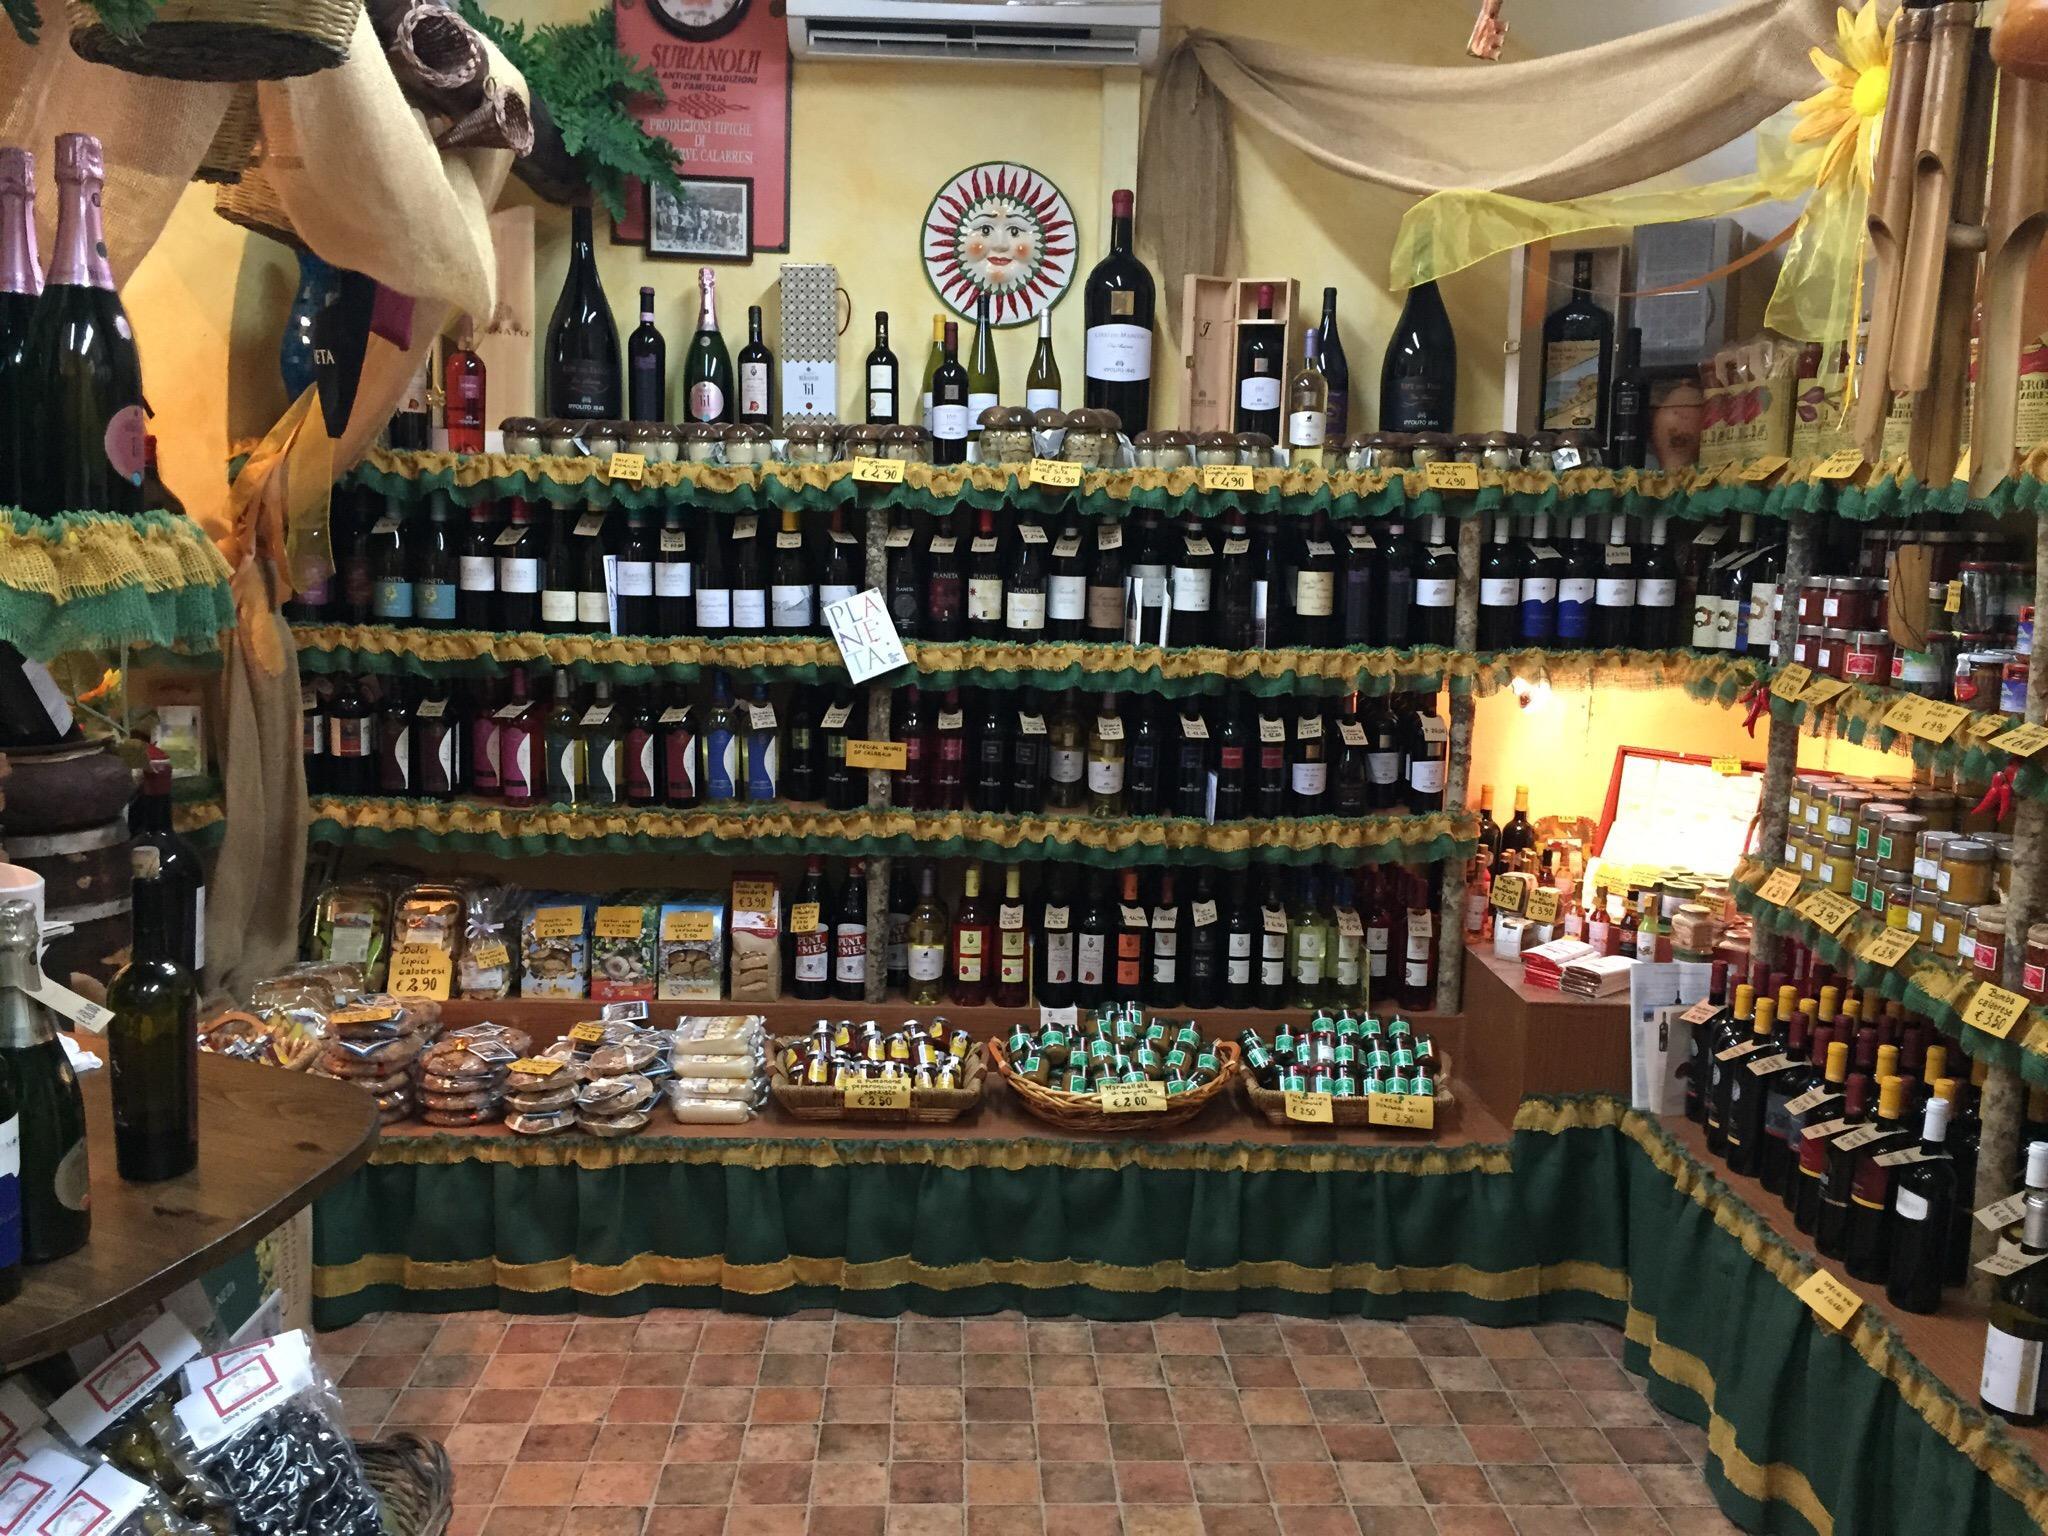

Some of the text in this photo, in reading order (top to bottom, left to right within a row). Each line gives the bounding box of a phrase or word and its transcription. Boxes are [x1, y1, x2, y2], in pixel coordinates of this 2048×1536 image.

[662, 72, 758, 85] ANTICHE TRADIZIONI
[671, 82, 727, 92] DI FAMIGLIA
[649, 119, 752, 136] PRODUZIONI TIPICHE
[694, 135, 706, 147] DI
[700, 150, 753, 163] CALABRESI
[797, 935, 822, 945] PUNT
[838, 936, 862, 946] PUNT
[400, 946, 428, 955] Dolci
[398, 967, 446, 976] calabresi
[396, 977, 438, 992] € 2.90
[1974, 1010, 1984, 1022] €
[857, 1096, 865, 1106] €
[1113, 1099, 1121, 1108] €
